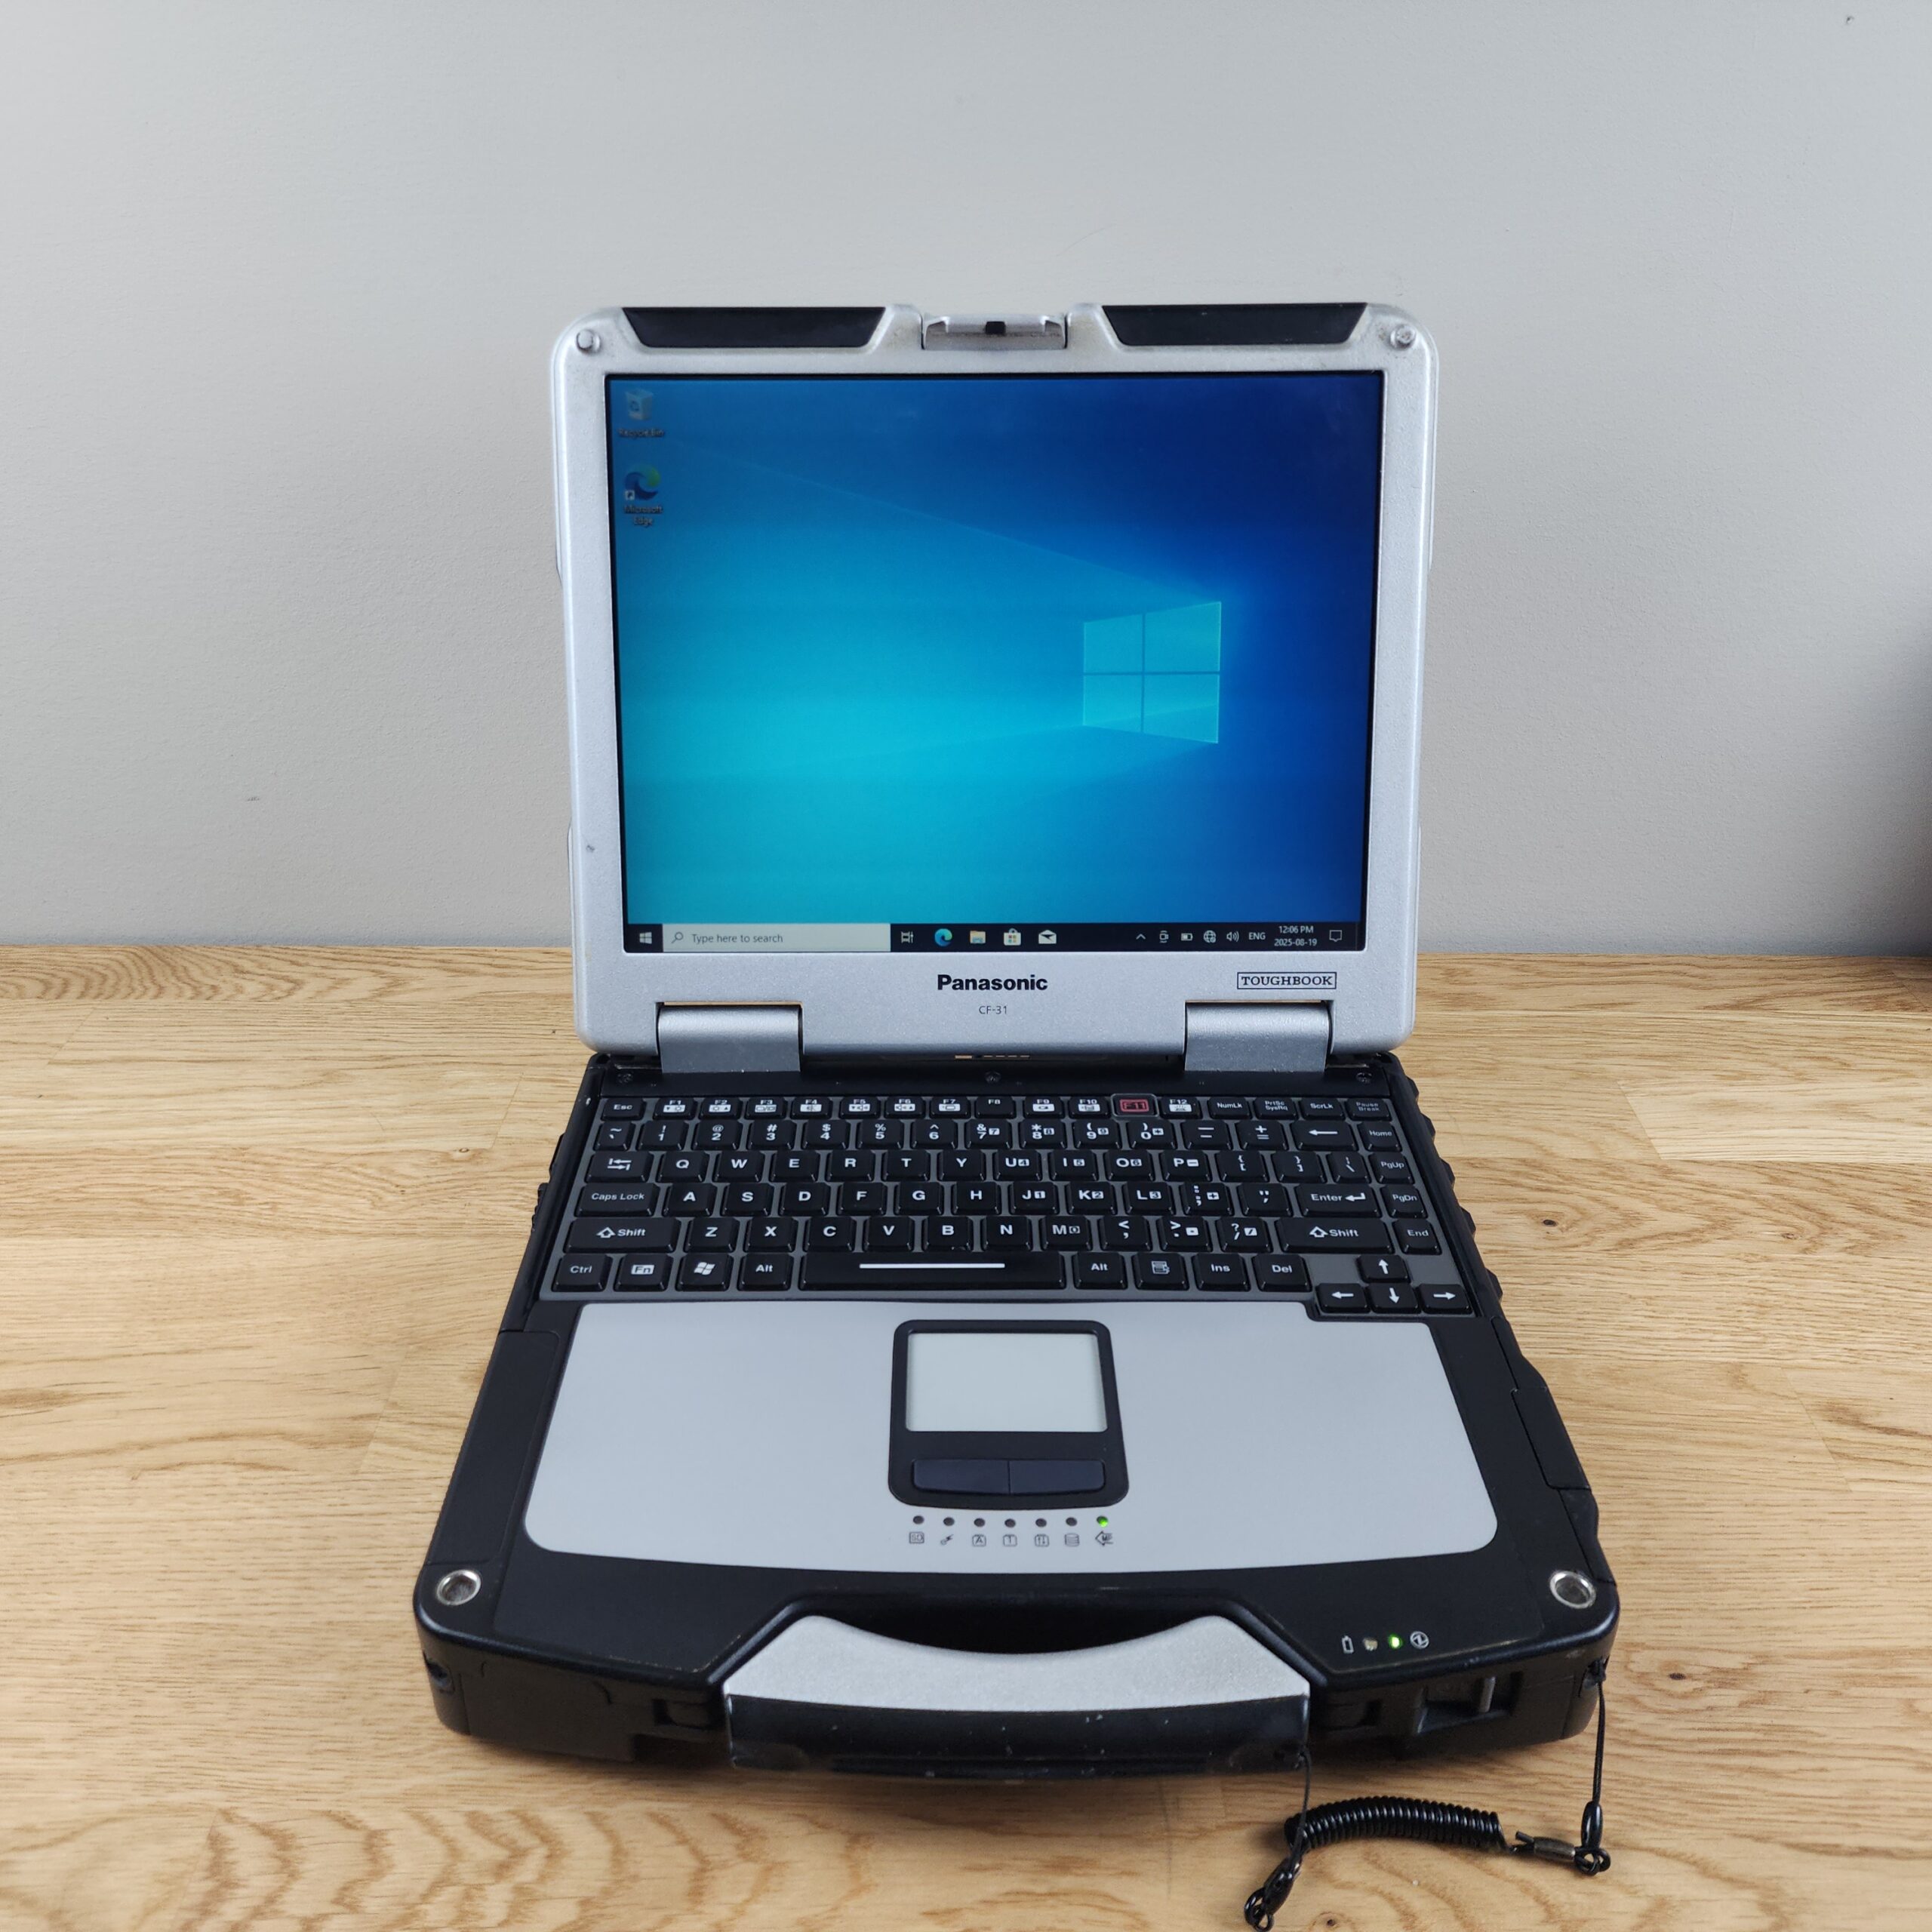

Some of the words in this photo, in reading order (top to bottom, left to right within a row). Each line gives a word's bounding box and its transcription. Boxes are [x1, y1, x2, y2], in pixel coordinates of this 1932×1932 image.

[625, 505, 662, 513] Microsoft
[634, 517, 653, 526] Edge
[1278, 925, 1299, 934] 12:06
[1300, 925, 1314, 934] PM
[692, 934, 714, 944] Type
[717, 934, 737, 943] here
[740, 934, 750, 943] to
[752, 934, 783, 943] search
[1248, 932, 1266, 940] ENG
[1274, 938, 1317, 946] 2025-08-19
[937, 974, 1048, 991] Panasonic
[1241, 975, 1334, 986] TOUGHBOOK
[978, 1005, 1008, 1015] CF-31
[658, 1133, 665, 1141] 1
[711, 1133, 721, 1141] 2
[766, 1133, 776, 1141] 3
[820, 1132, 830, 1140] 4
[929, 1131, 939, 1140] 6
[1032, 1131, 1042, 1140] 8
[1086, 1131, 1097, 1140] 9
[675, 1159, 690, 1168] Q
[731, 1159, 748, 1168] W
[789, 1158, 800, 1168] E
[844, 1158, 857, 1168] R
[901, 1158, 912, 1168] T
[956, 1158, 967, 1168] Y
[1005, 1158, 1017, 1168] U
[1116, 1158, 1129, 1168] O
[1173, 1158, 1184, 1167] P
[1380, 1161, 1404, 1170] PgUp
[592, 1192, 617, 1201] Caps
[683, 1192, 696, 1201] A
[741, 1192, 754, 1202] S
[798, 1191, 811, 1201] D
[857, 1191, 867, 1201] F
[912, 1191, 926, 1201] G
[970, 1190, 982, 1200] H
[1022, 1190, 1031, 1200] J
[1078, 1190, 1092, 1200] K
[1137, 1190, 1148, 1200] L
[1392, 1194, 1417, 1203] PgDn
[617, 1228, 646, 1237] Shift
[705, 1227, 718, 1237] Z
[764, 1226, 777, 1237] X
[823, 1226, 836, 1236] C
[883, 1226, 895, 1235] V
[942, 1225, 955, 1235] B
[1000, 1225, 1013, 1235] N
[1052, 1225, 1067, 1235] M
[1329, 1229, 1358, 1237] Shift
[570, 1266, 592, 1274] Ctrl
[1091, 1263, 1108, 1271] Alt
[1211, 1264, 1230, 1272] Ins
[1272, 1265, 1292, 1273] Del
